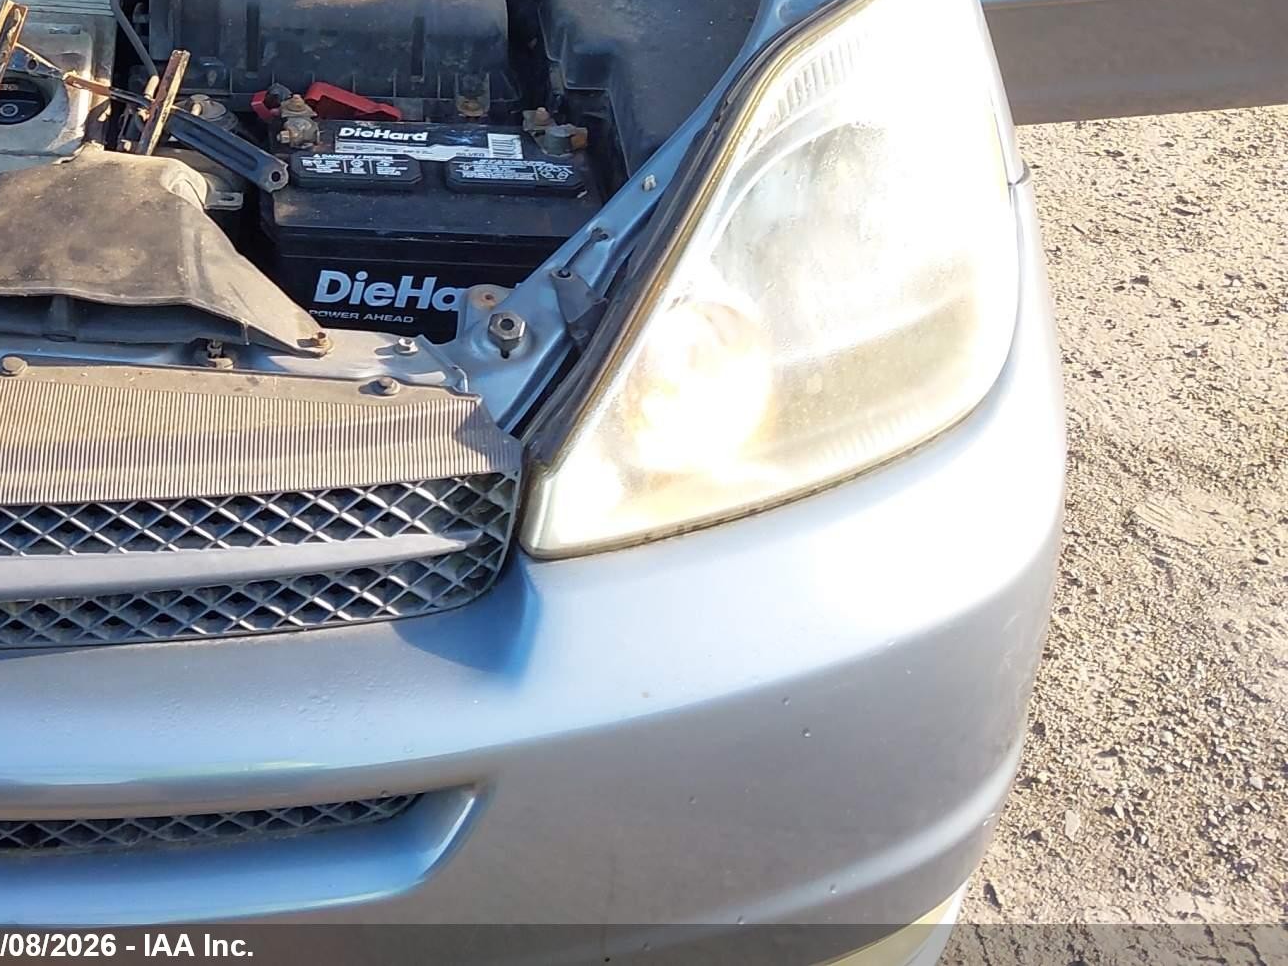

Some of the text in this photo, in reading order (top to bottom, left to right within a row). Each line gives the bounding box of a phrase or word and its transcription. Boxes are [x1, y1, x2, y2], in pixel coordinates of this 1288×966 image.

[338, 127, 429, 141] DieHard
[313, 269, 462, 312] DieHa
[308, 309, 414, 323] POWER AHEAD
